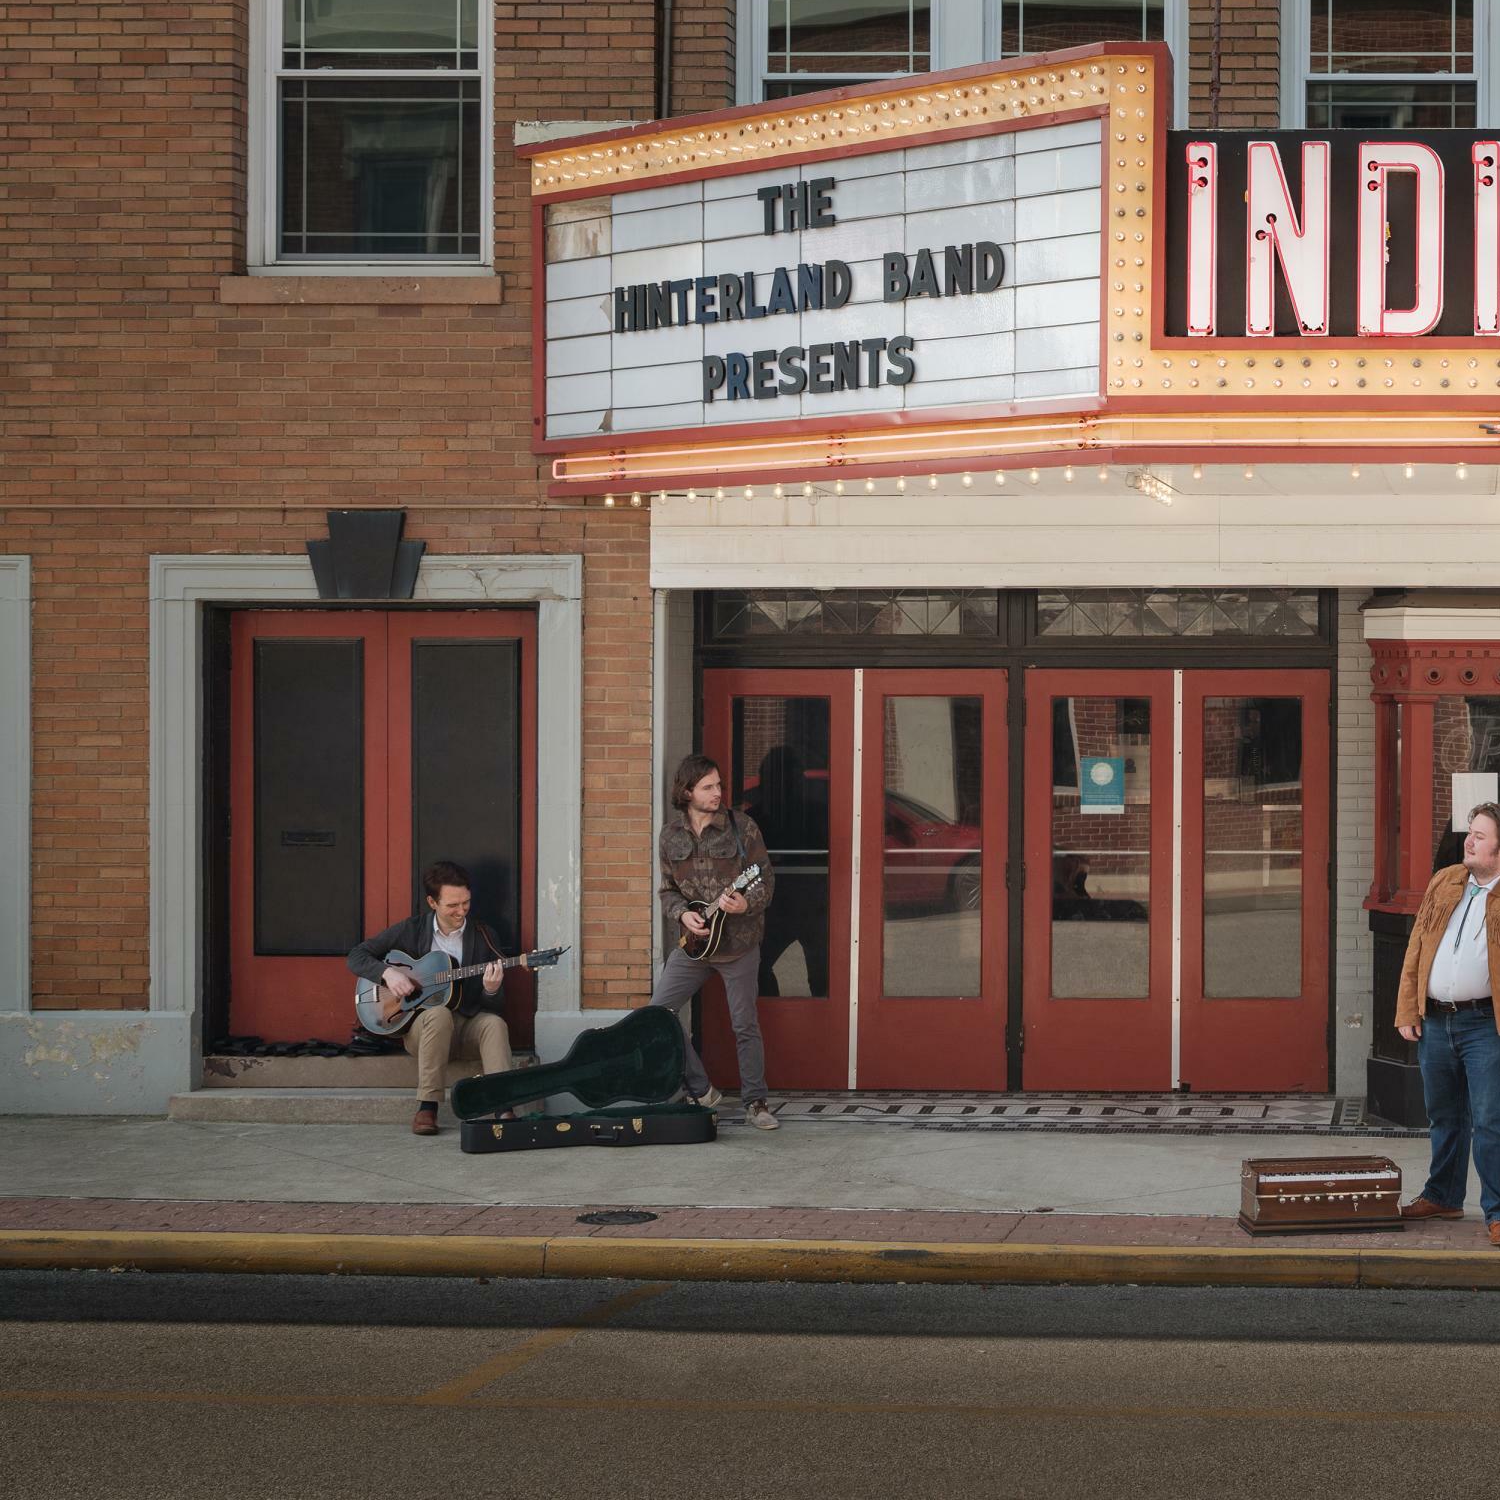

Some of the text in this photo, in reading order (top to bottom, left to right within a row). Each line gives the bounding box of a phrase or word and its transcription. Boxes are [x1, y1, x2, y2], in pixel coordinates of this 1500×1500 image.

[757, 176, 836, 236] THE
[614, 241, 1004, 334] HINTERLAND BAND
[702, 335, 915, 403] PRESENTS
[807, 1104, 1236, 1116] INDIANA
